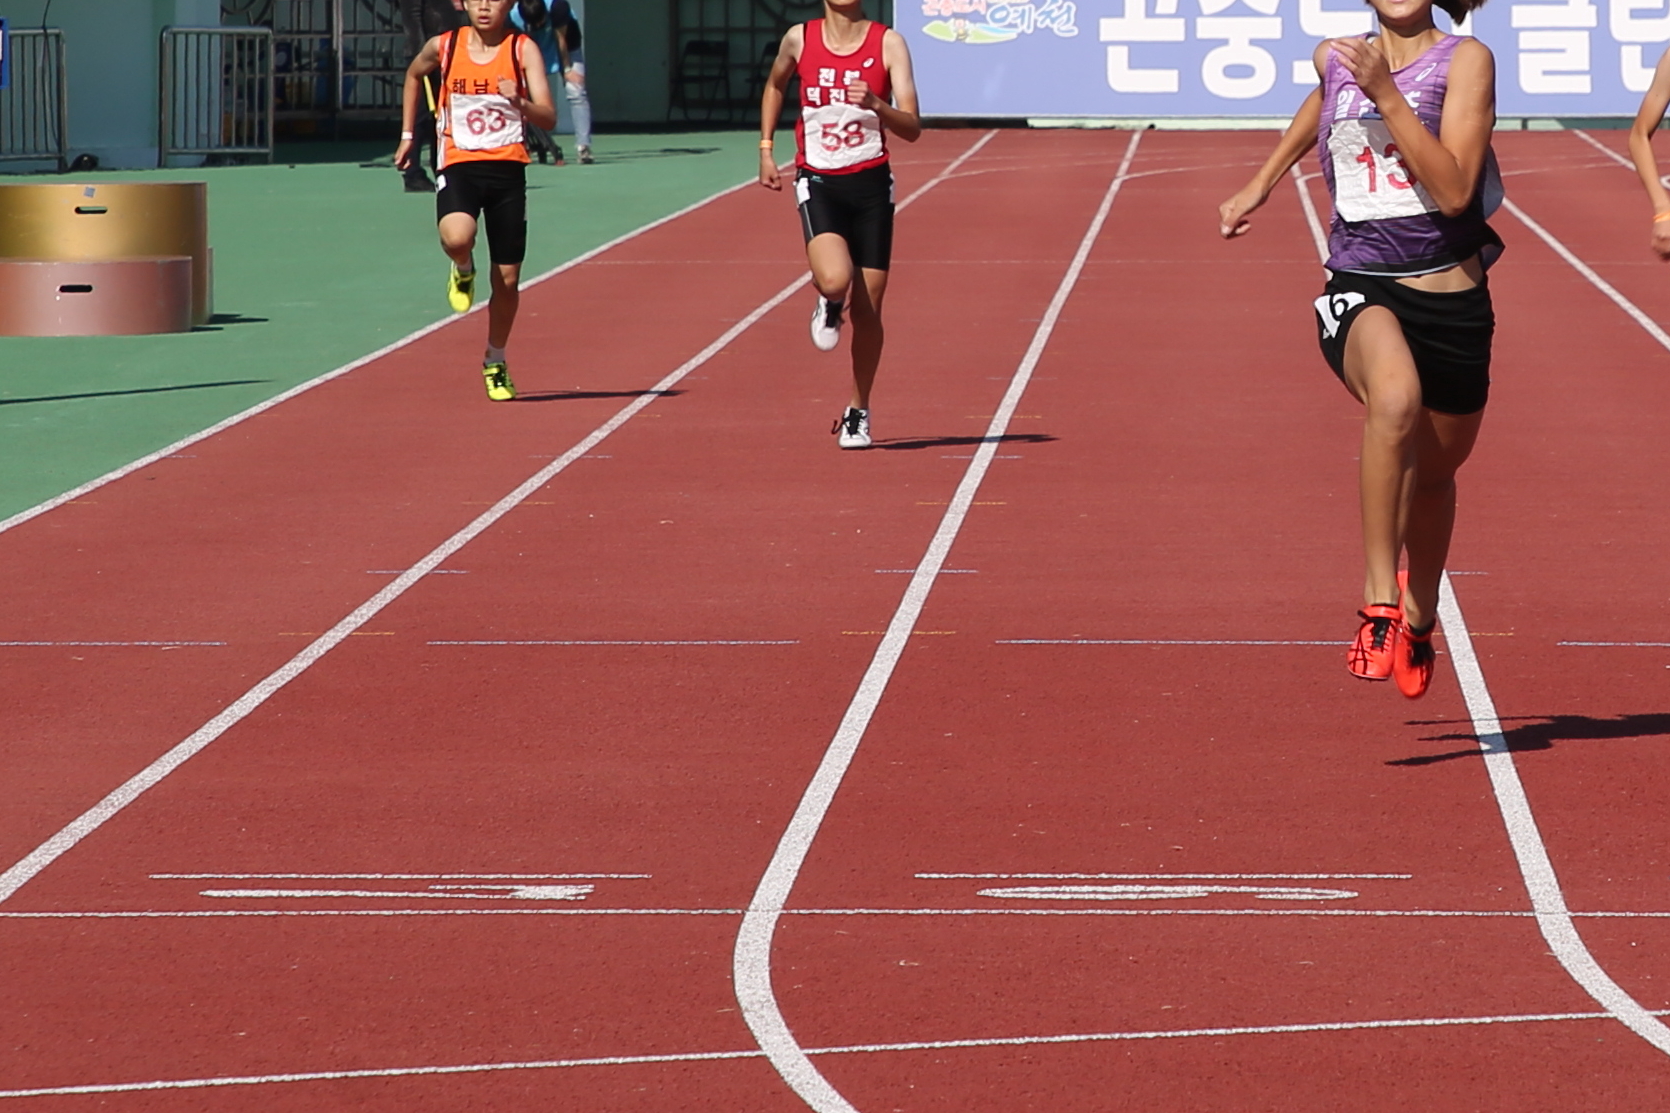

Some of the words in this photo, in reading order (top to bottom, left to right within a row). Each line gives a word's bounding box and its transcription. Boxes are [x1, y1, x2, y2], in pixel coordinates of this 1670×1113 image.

[466, 109, 506, 135] 63
[821, 121, 866, 151] 58
[1357, 143, 1417, 192] 13
